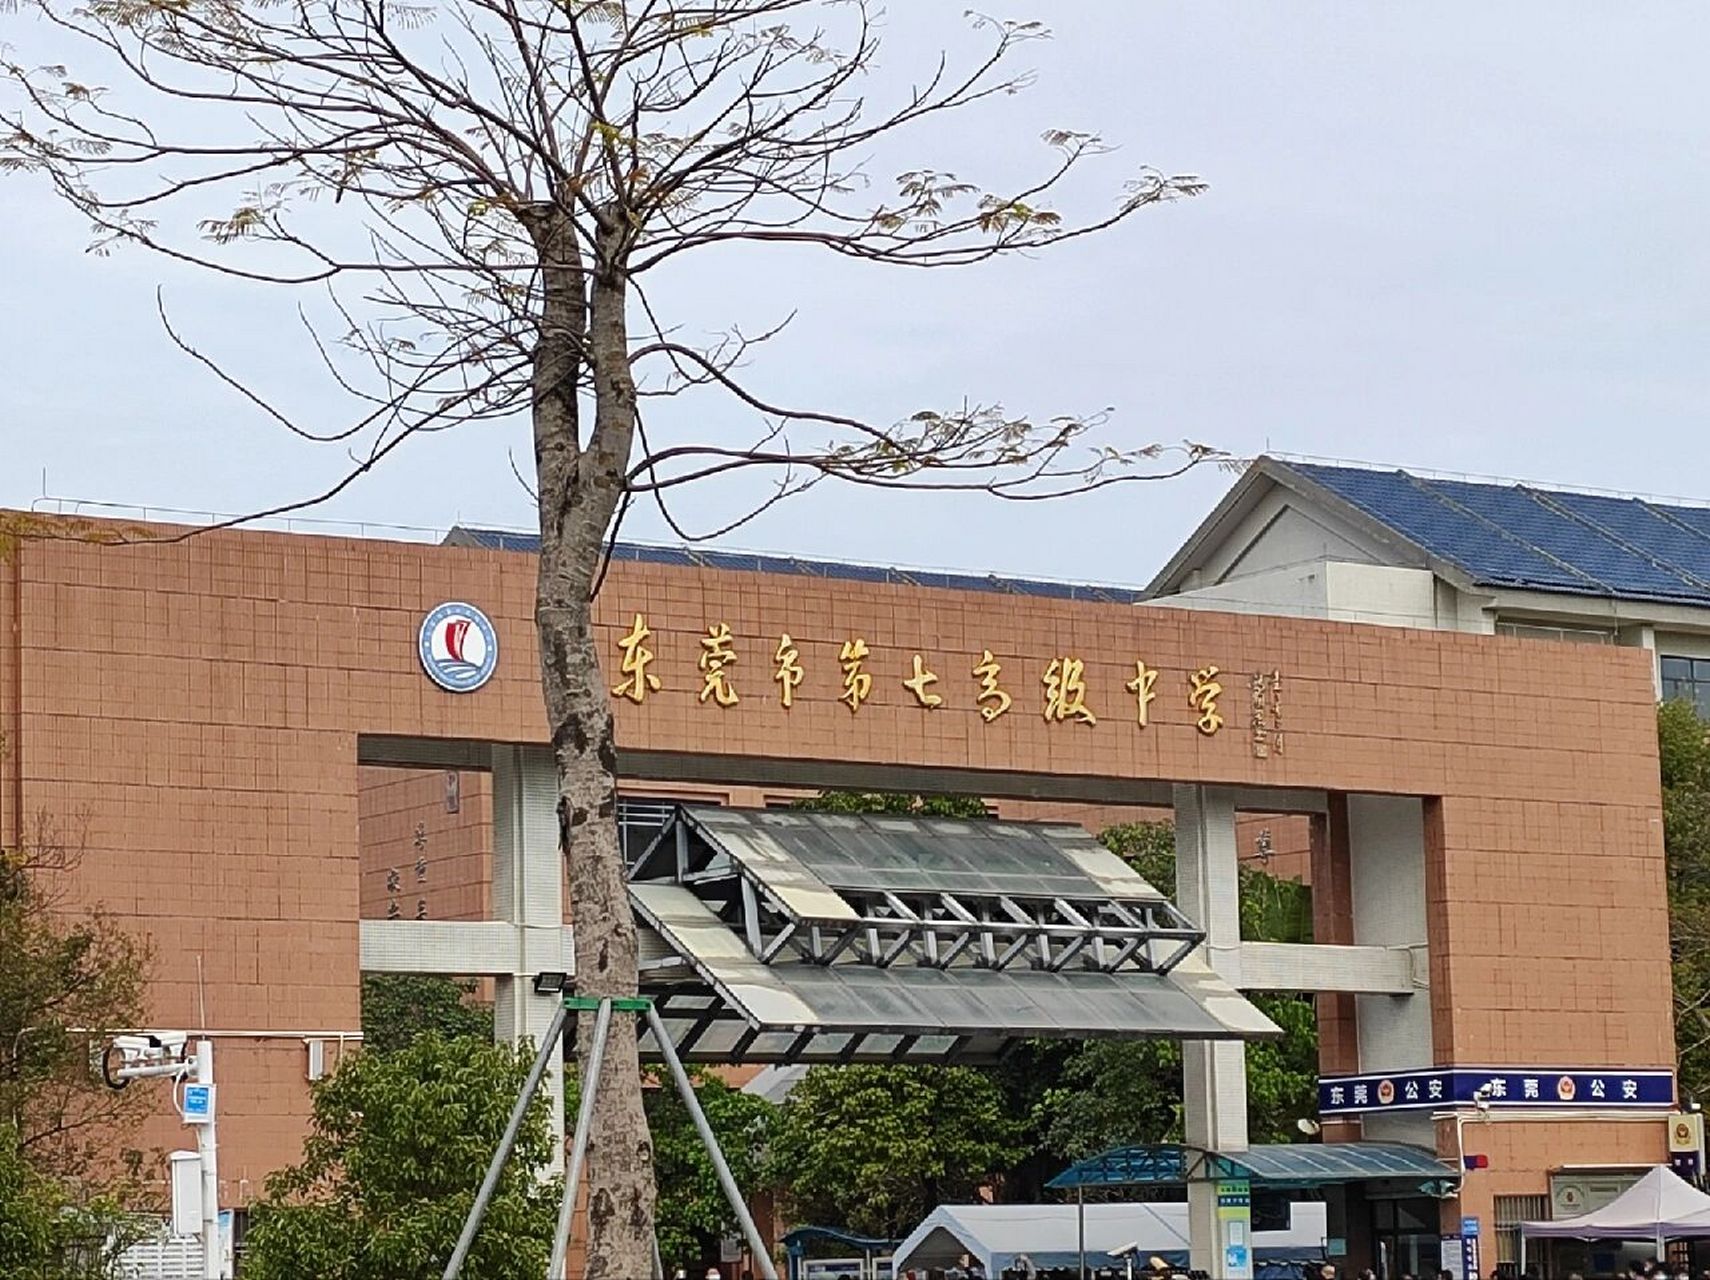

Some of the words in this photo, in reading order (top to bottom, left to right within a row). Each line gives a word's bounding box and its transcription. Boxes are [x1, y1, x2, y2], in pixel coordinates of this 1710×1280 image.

[612, 613, 1224, 736] 东莞市第七高级中学
[1330, 1085, 1369, 1105] 东莞
[1405, 1079, 1443, 1100] 公安
[1490, 1078, 1540, 1099] 东莞
[1590, 1079, 1639, 1100] 公安
